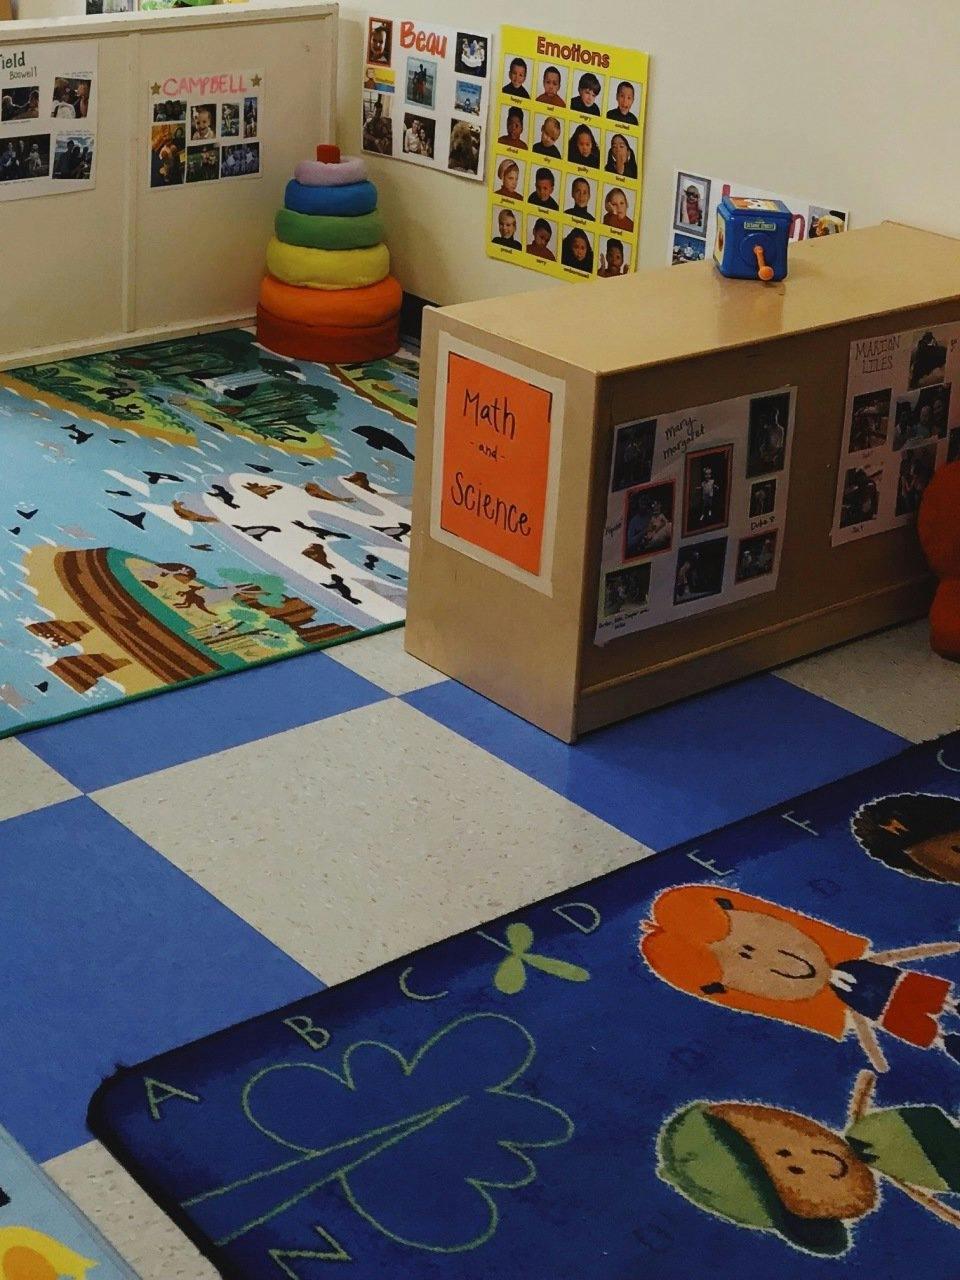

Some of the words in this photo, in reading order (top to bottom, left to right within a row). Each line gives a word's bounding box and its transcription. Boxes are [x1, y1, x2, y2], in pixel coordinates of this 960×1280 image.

[400, 21, 448, 58] Beau
[537, 36, 611, 68] Emotions
[163, 74, 248, 96] CAMPBELL
[463, 388, 516, 440] Math
[451, 470, 531, 536] Science
[144, 1077, 200, 1120] A
[283, 1015, 331, 1050] B
[399, 967, 449, 1000] C
[553, 902, 601, 934] D
[686, 849, 736, 876] E
